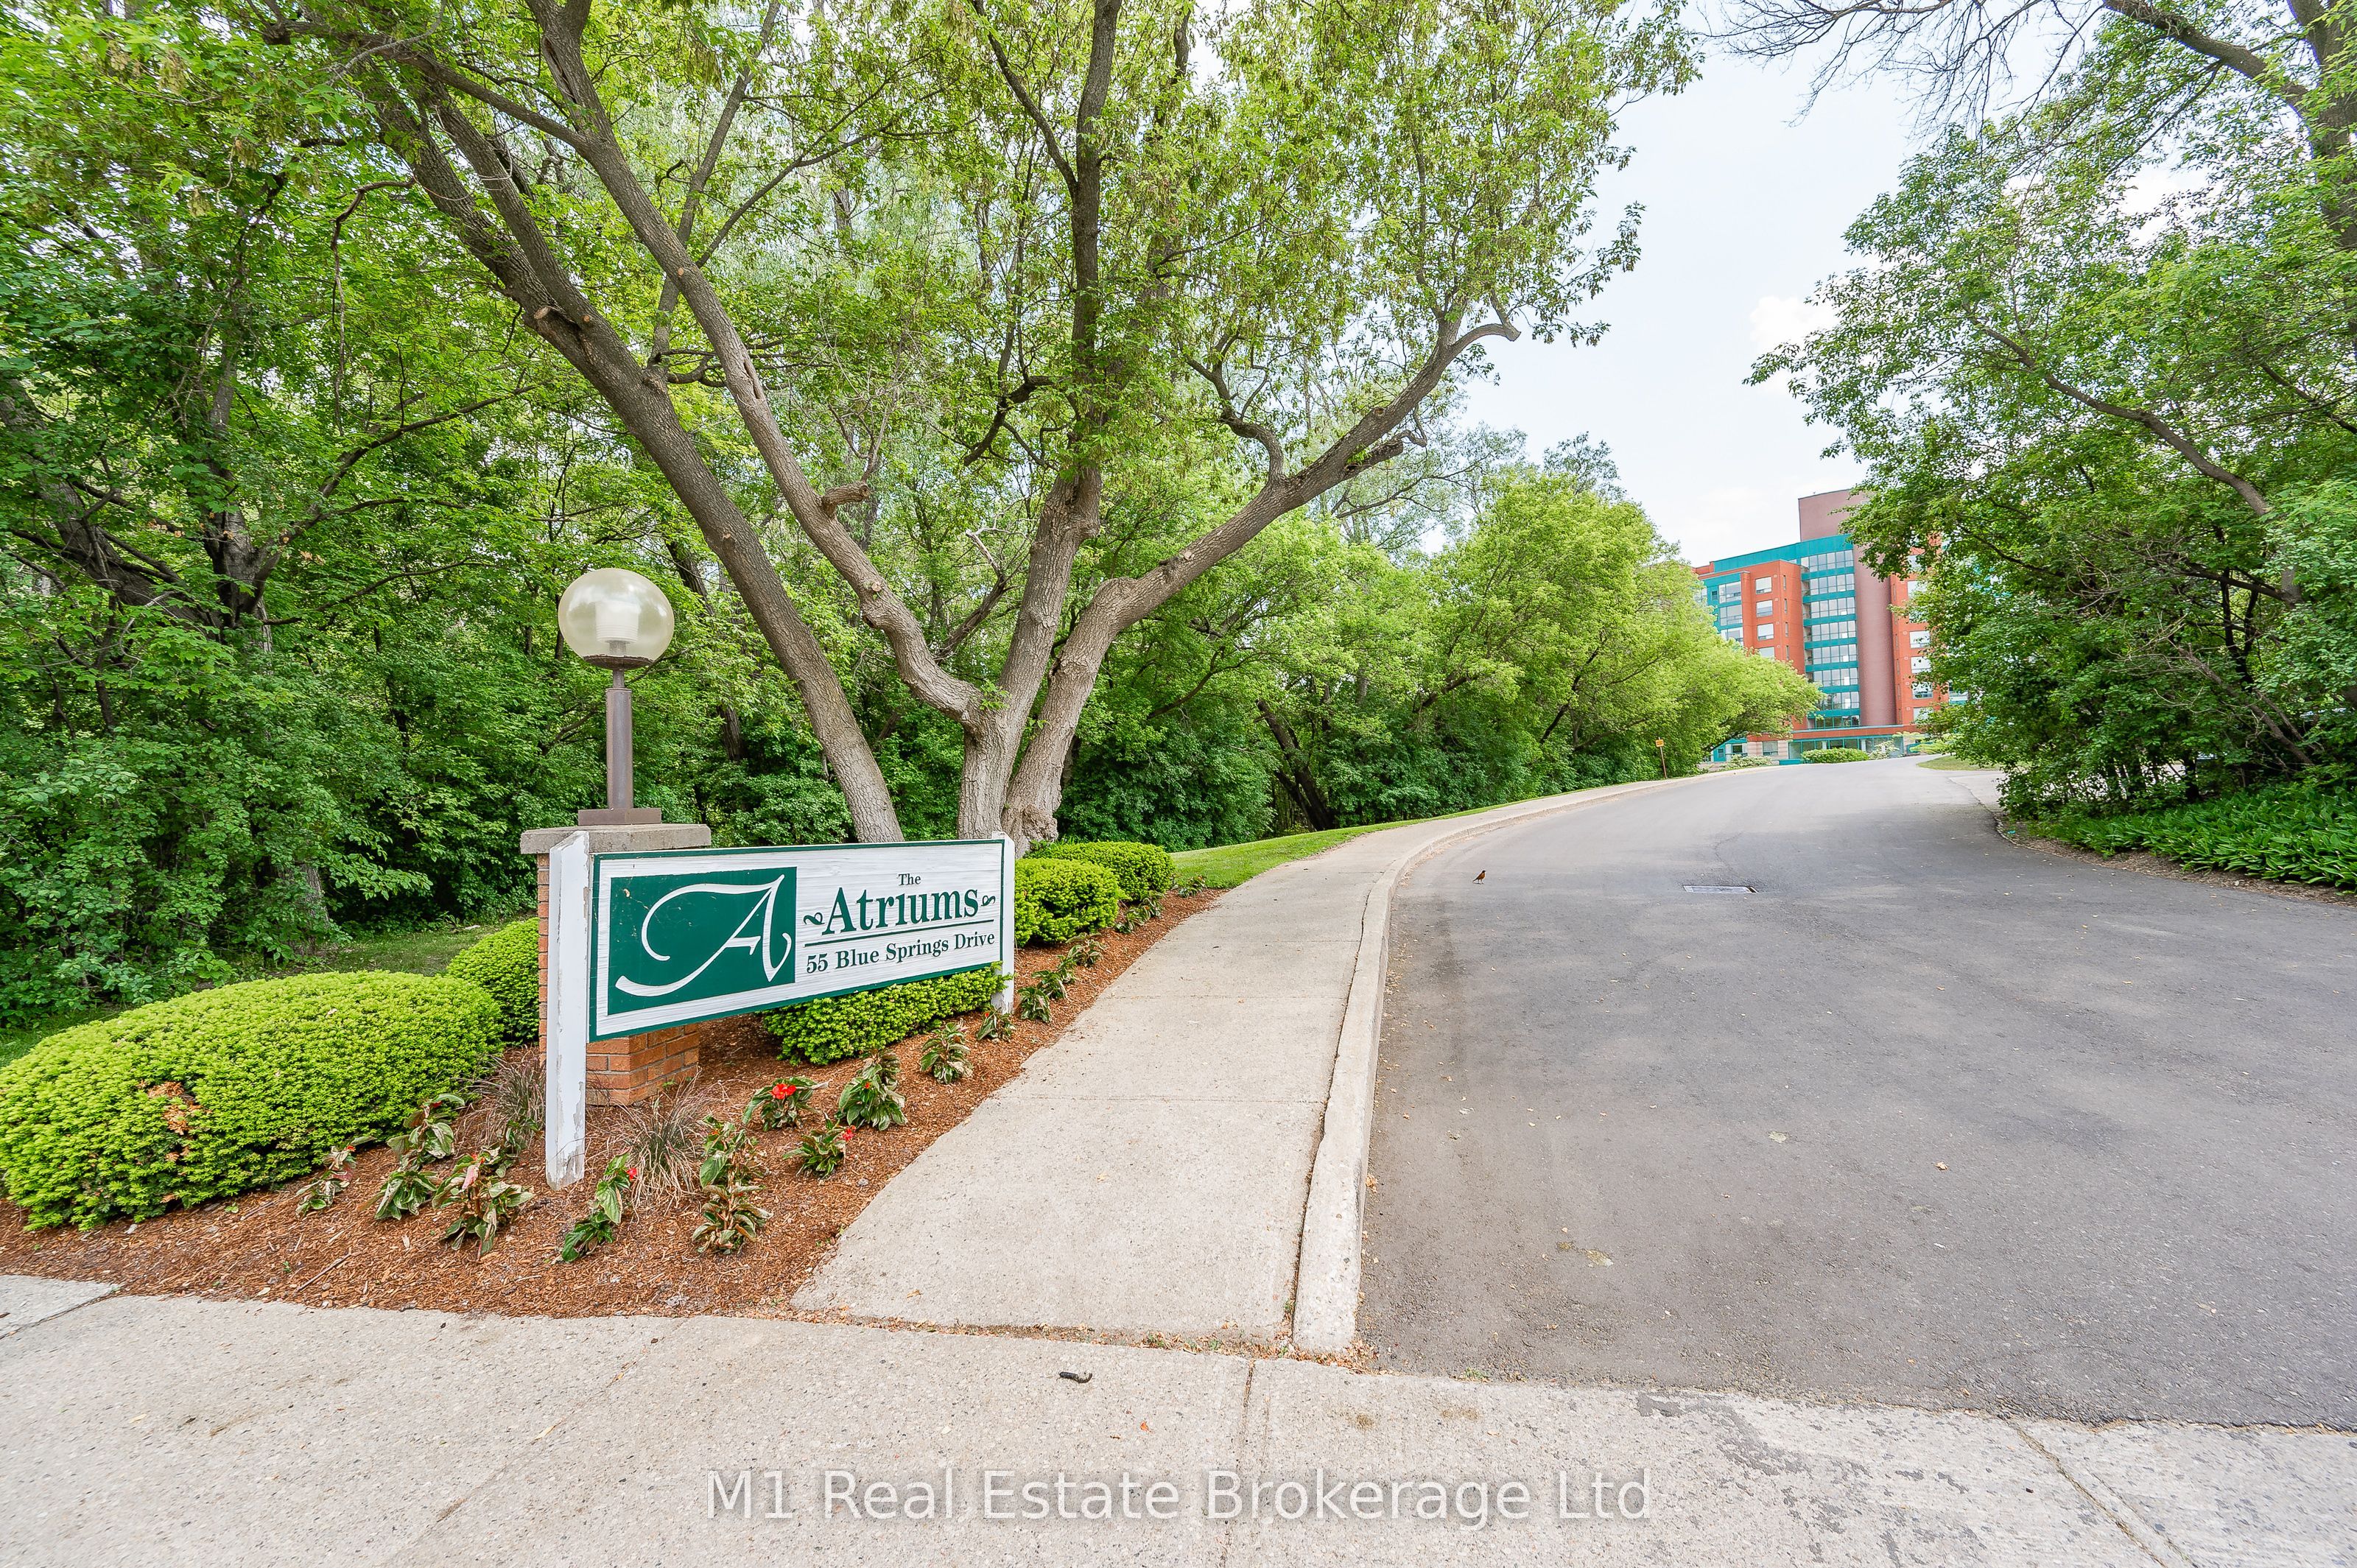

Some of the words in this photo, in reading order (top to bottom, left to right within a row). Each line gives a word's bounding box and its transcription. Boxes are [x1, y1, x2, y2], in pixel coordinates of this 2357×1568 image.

[898, 873, 921, 886] The
[822, 887, 979, 935] Atriums
[806, 953, 828, 973] 55
[835, 949, 879, 968] Blue
[885, 939, 949, 963] Springs
[954, 931, 994, 949] Drive
